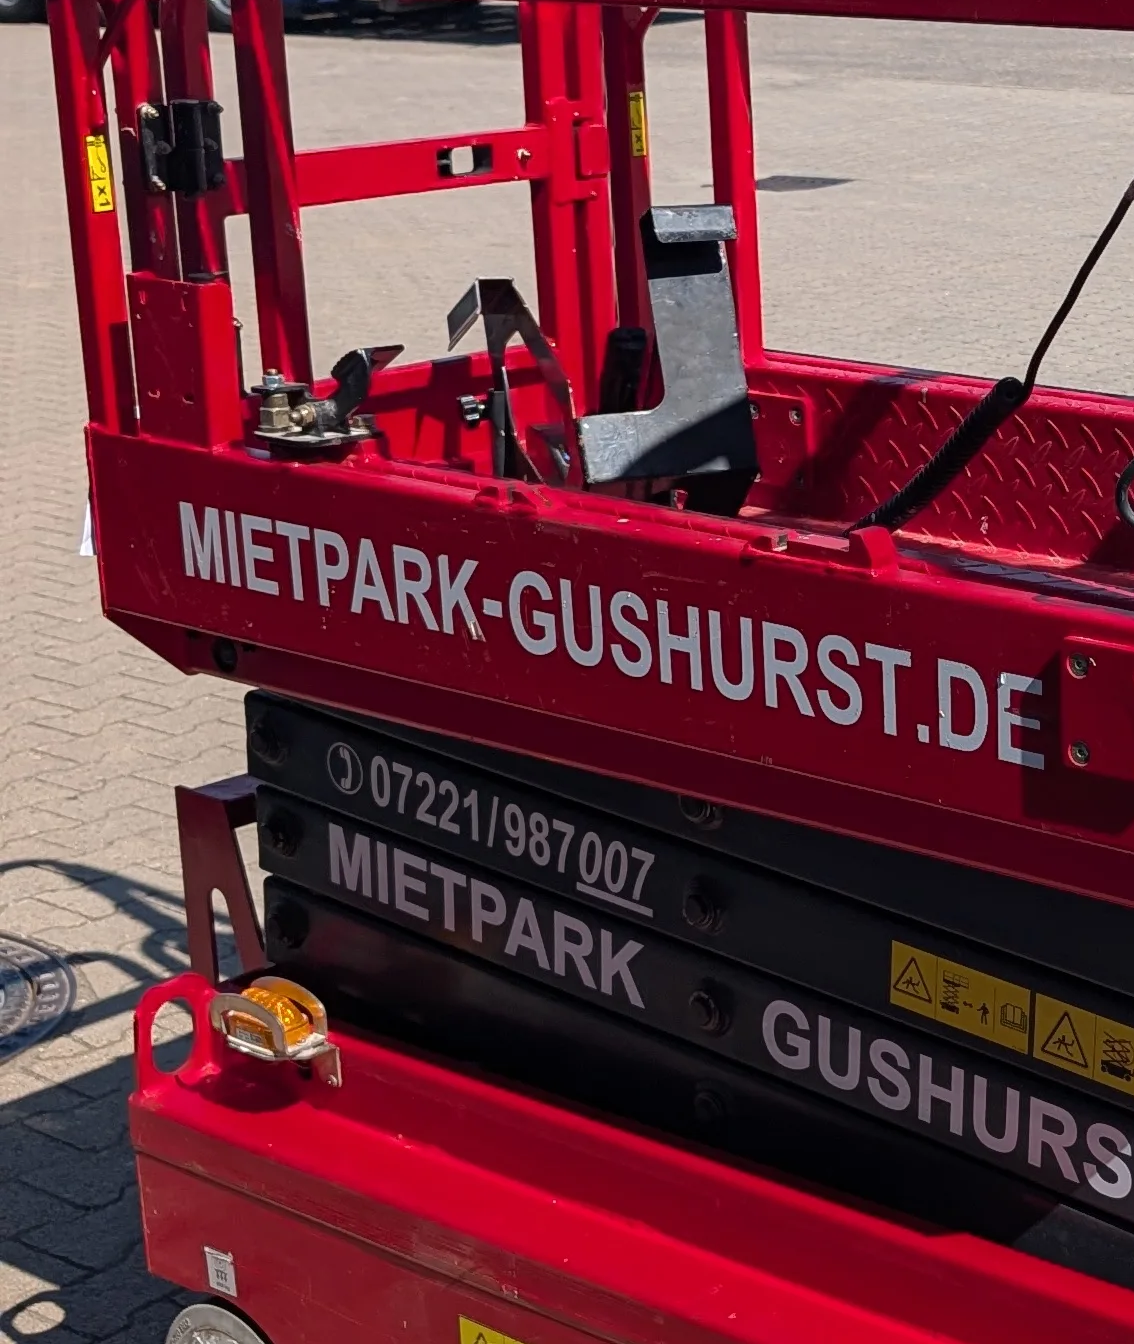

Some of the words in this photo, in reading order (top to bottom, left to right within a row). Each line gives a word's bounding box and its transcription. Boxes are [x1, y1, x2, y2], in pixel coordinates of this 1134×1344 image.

[179, 501, 1045, 771] MIETPARK-GUSHURST.DE
[328, 822, 646, 1010] MIETPARK
[370, 755, 655, 902] 07221/987007
